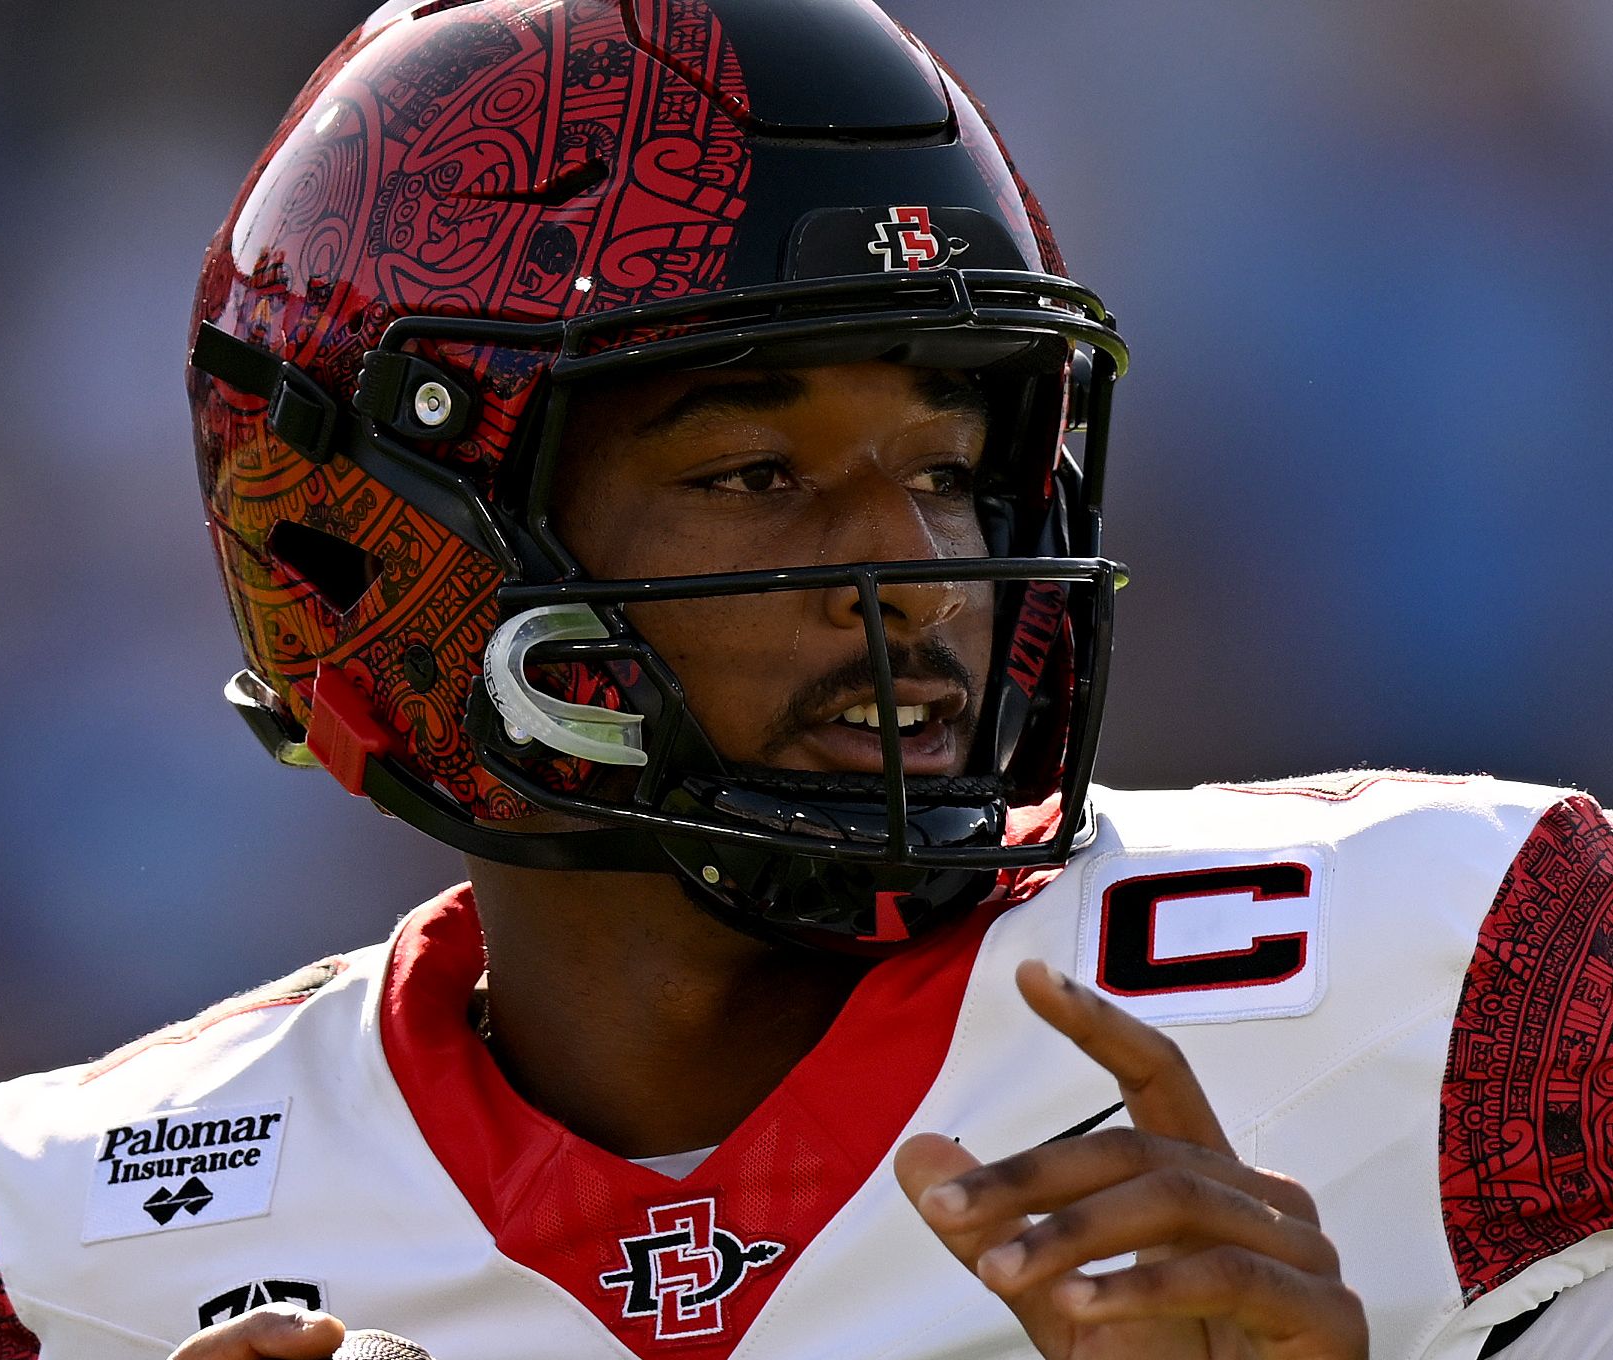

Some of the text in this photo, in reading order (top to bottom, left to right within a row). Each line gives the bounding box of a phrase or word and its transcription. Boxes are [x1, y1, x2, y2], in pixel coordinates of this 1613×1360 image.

[1095, 861, 1312, 997] C
[99, 1113, 281, 1162] Palomar
[107, 1146, 261, 1185] Insurance
